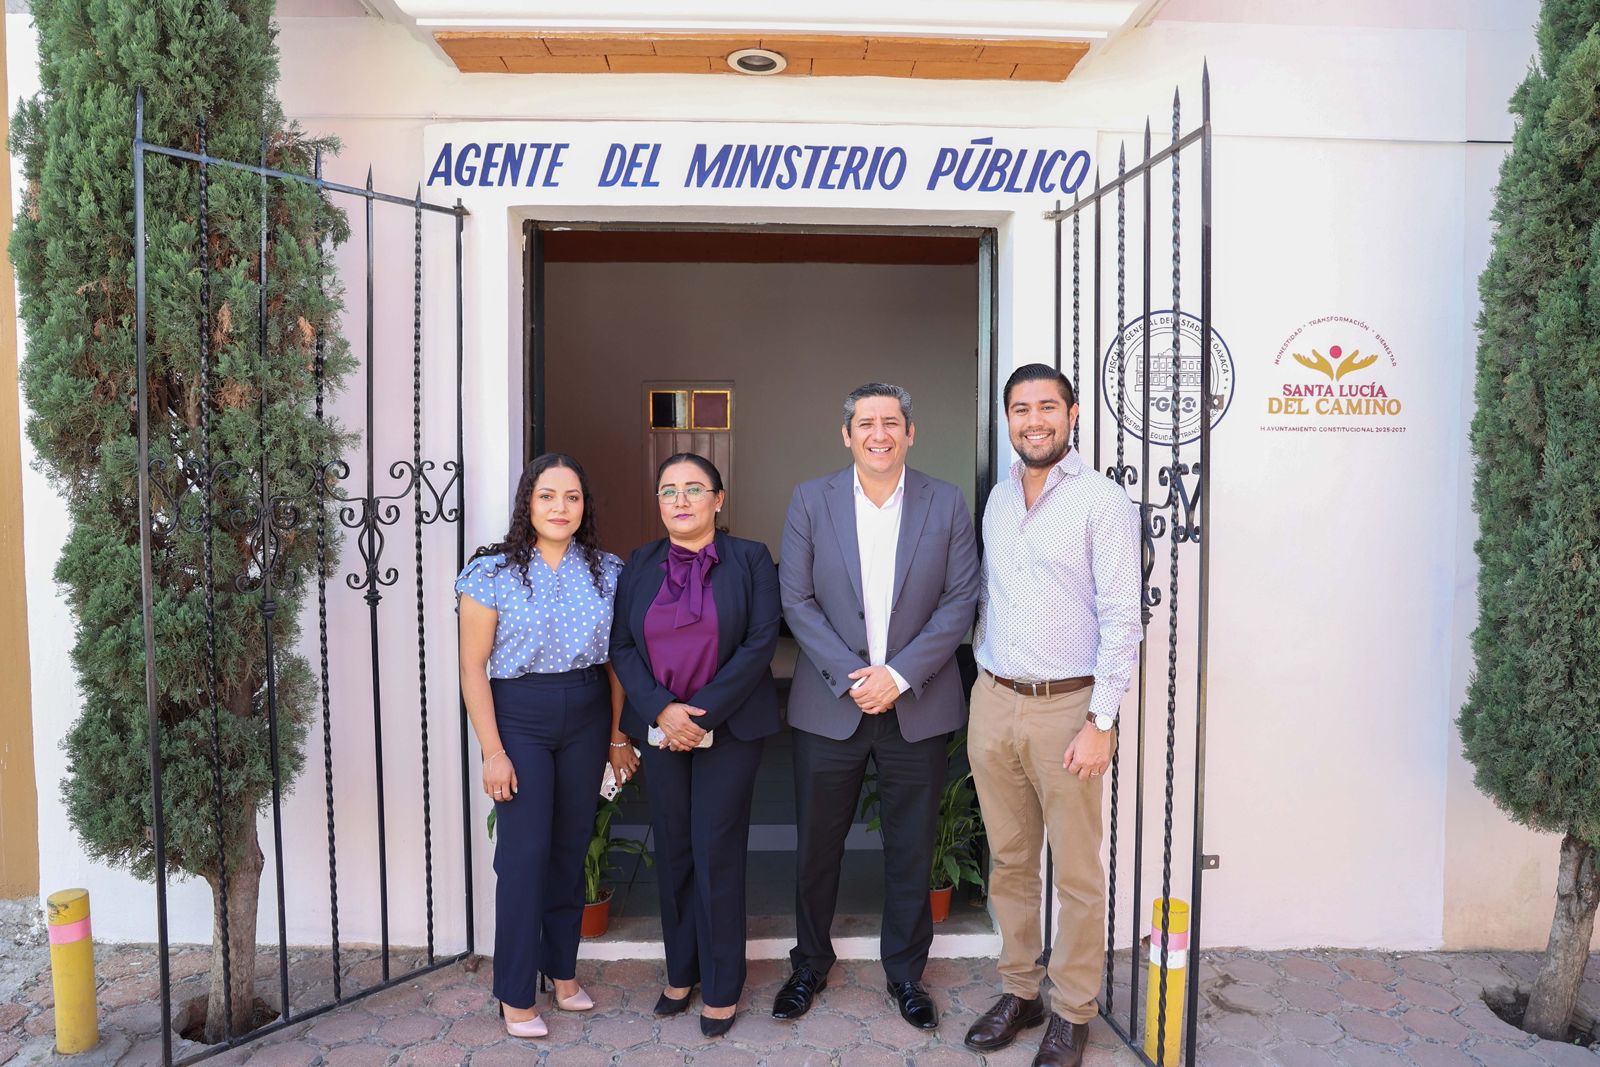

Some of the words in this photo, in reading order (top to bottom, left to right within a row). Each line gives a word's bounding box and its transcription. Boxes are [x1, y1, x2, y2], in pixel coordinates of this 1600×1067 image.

[428, 143, 569, 188] AGENTE
[599, 144, 661, 188] DEL
[685, 144, 907, 191] MINISTERIO
[928, 137, 1090, 194] PÚBLICO
[1274, 327, 1303, 365] HONESTIDAD
[1308, 316, 1370, 331] TRANSFORMACIÓN
[1375, 334, 1397, 367] BIENESTAR
[1212, 343, 1230, 375] OAXACA
[1282, 383, 1335, 398] SANTA
[1339, 381, 1388, 398] LUCÍA
[1267, 397, 1309, 415] DEL
[1315, 398, 1402, 416] CAMINO
